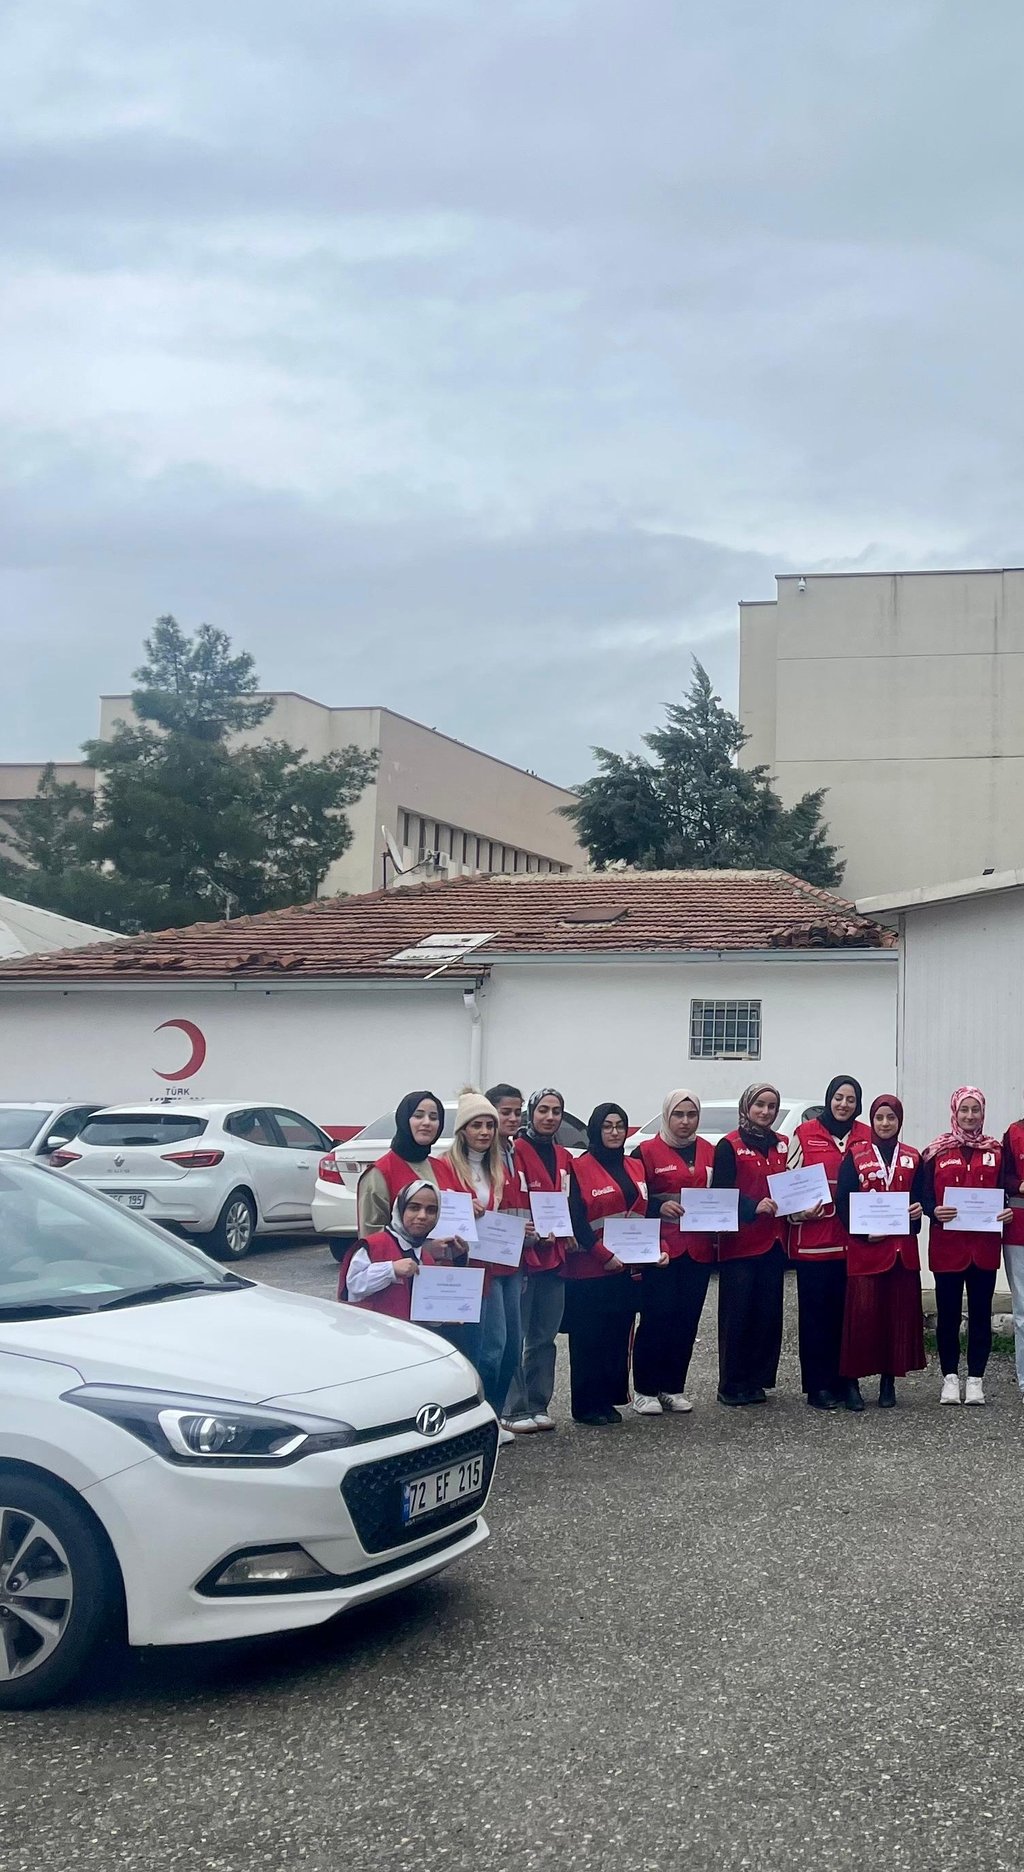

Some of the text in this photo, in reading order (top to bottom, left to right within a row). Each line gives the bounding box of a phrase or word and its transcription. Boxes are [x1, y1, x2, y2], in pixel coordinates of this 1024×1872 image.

[165, 1086, 190, 1096] TÜRK
[128, 1195, 142, 1205] 195
[410, 1481, 426, 1513] 72
[436, 1471, 450, 1503] EF
[458, 1460, 480, 1492] 215
